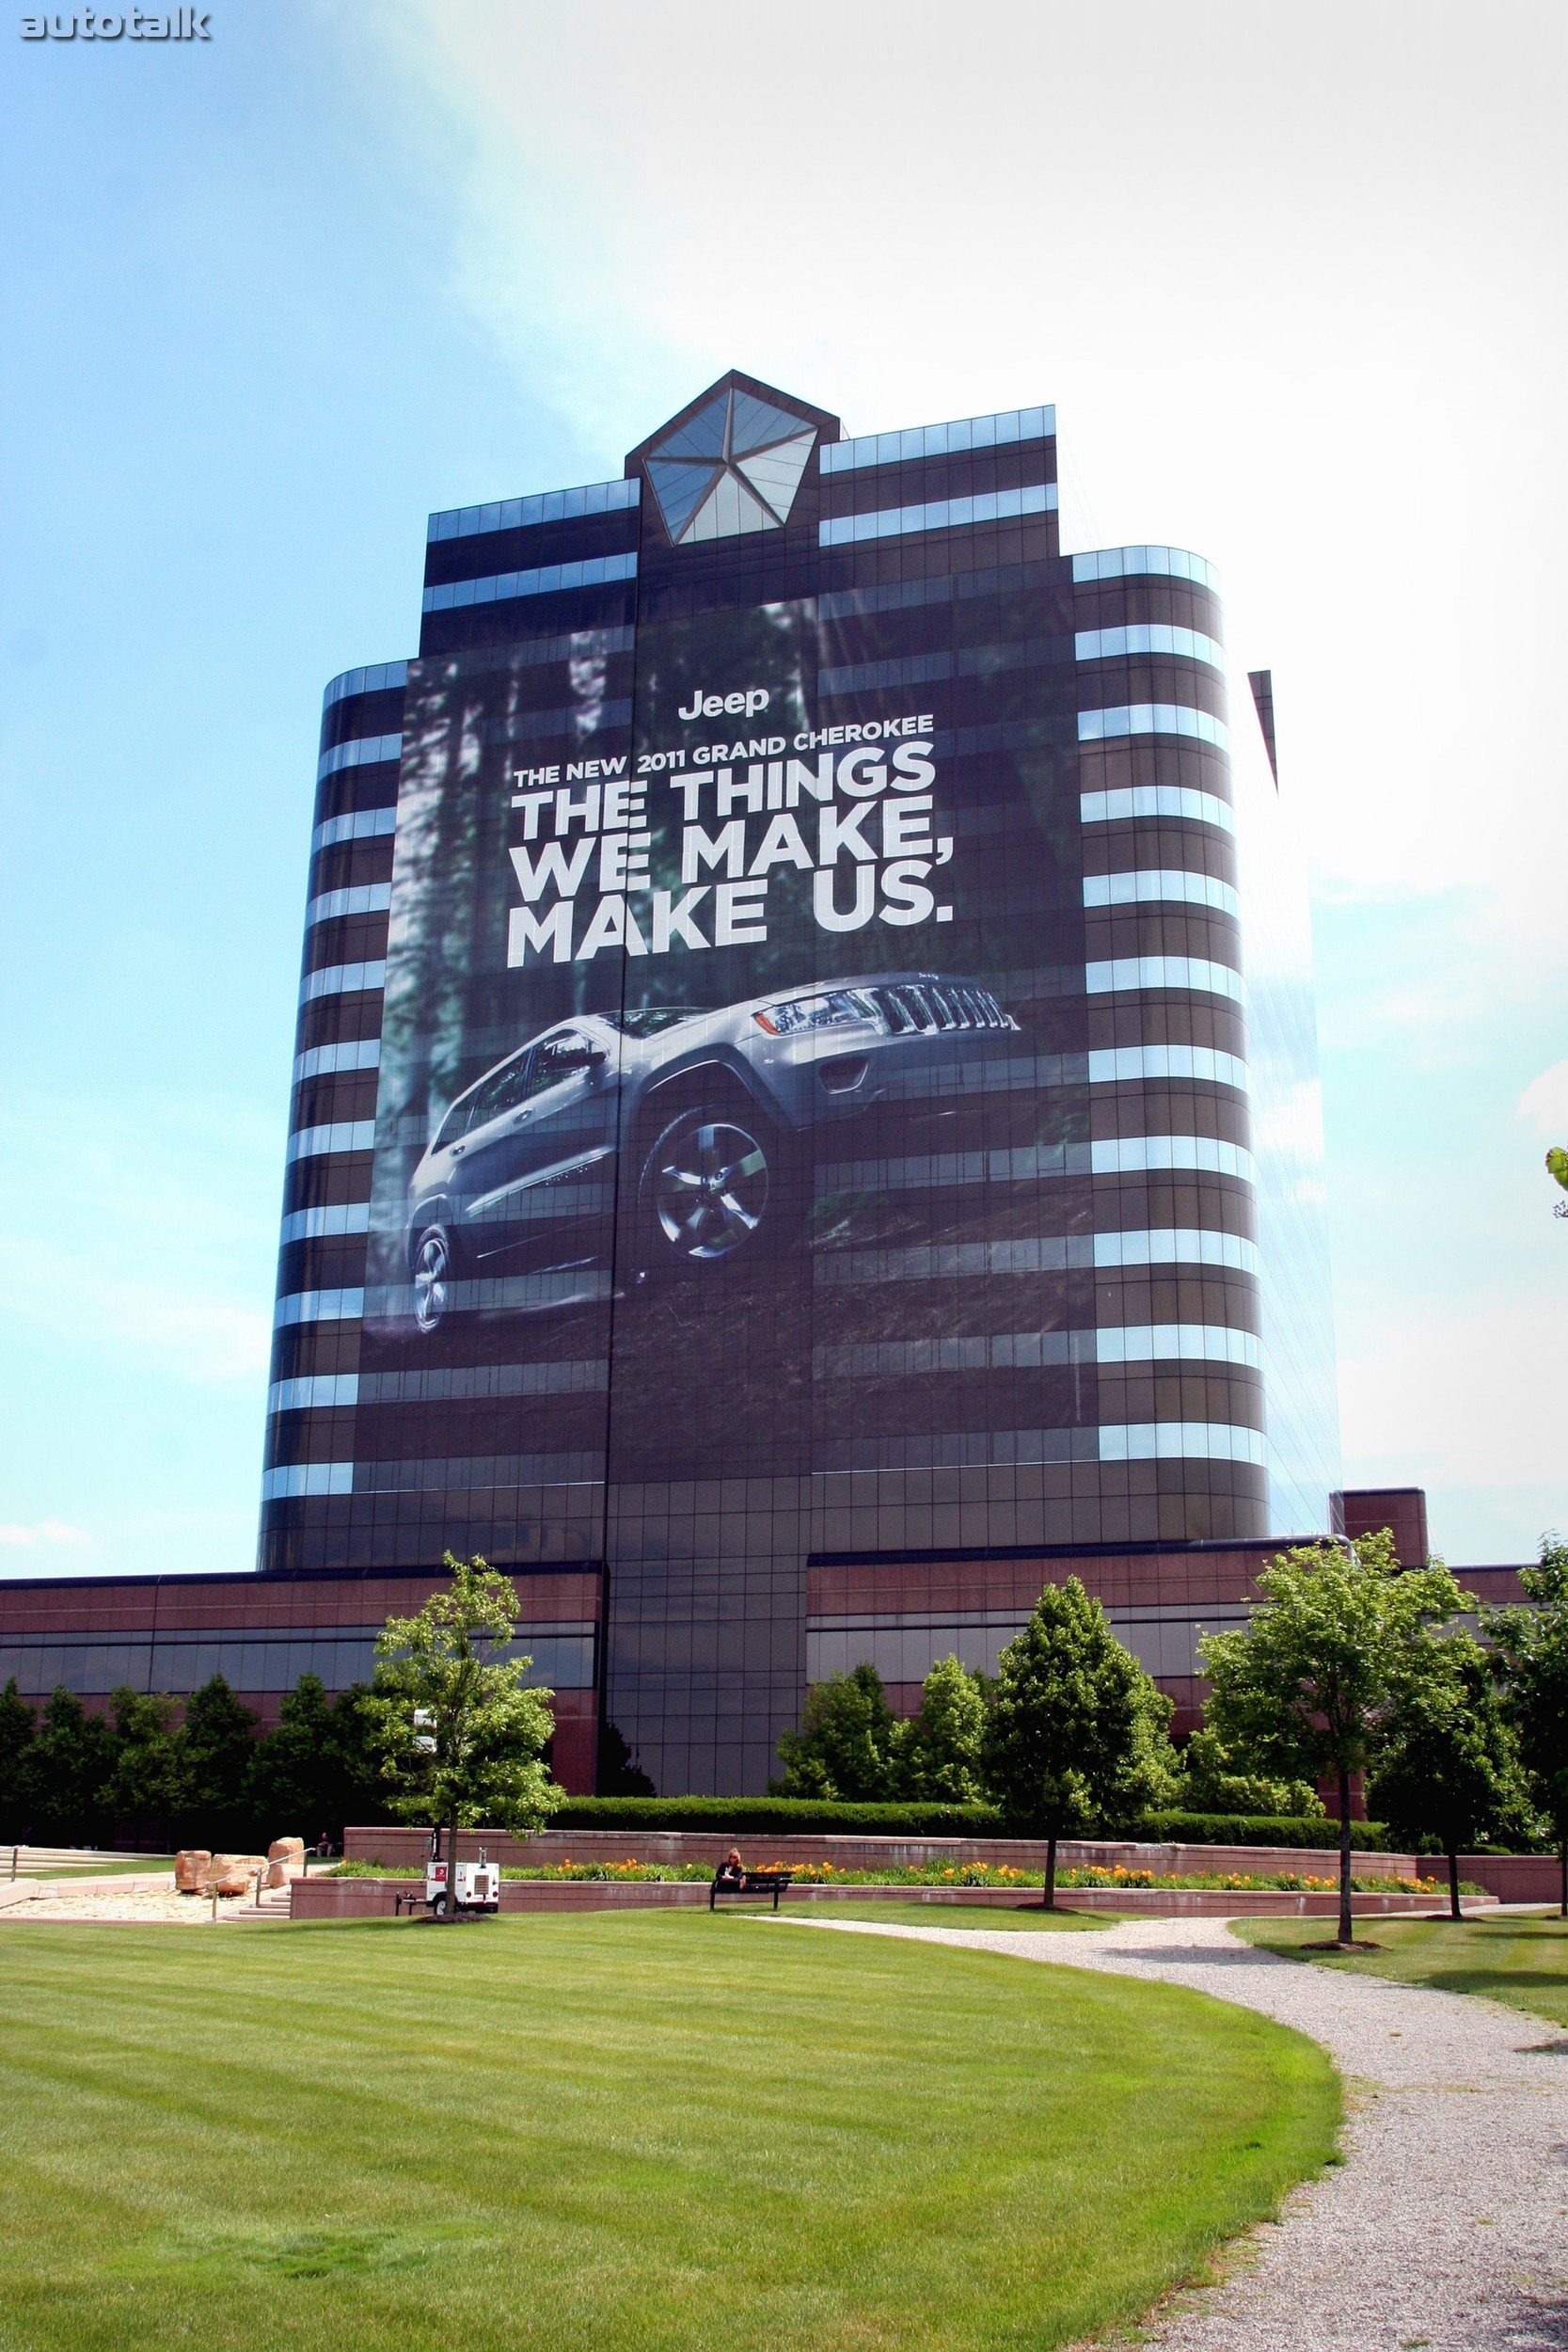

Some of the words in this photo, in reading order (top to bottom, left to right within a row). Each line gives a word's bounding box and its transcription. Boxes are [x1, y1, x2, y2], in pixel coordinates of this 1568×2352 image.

[514, 767, 560, 788] THE
[566, 756, 626, 781] NEW
[637, 750, 686, 772] 2011
[692, 737, 785, 764] GRAND
[793, 714, 934, 751] CHEROKEE
[678, 689, 769, 721] Jeep
[511, 780, 648, 841] THE
[670, 741, 936, 820] THINGS
[508, 832, 651, 902] WE
[681, 795, 954, 884] MAKE,
[507, 879, 768, 969] MAKE
[813, 860, 954, 933] US.
